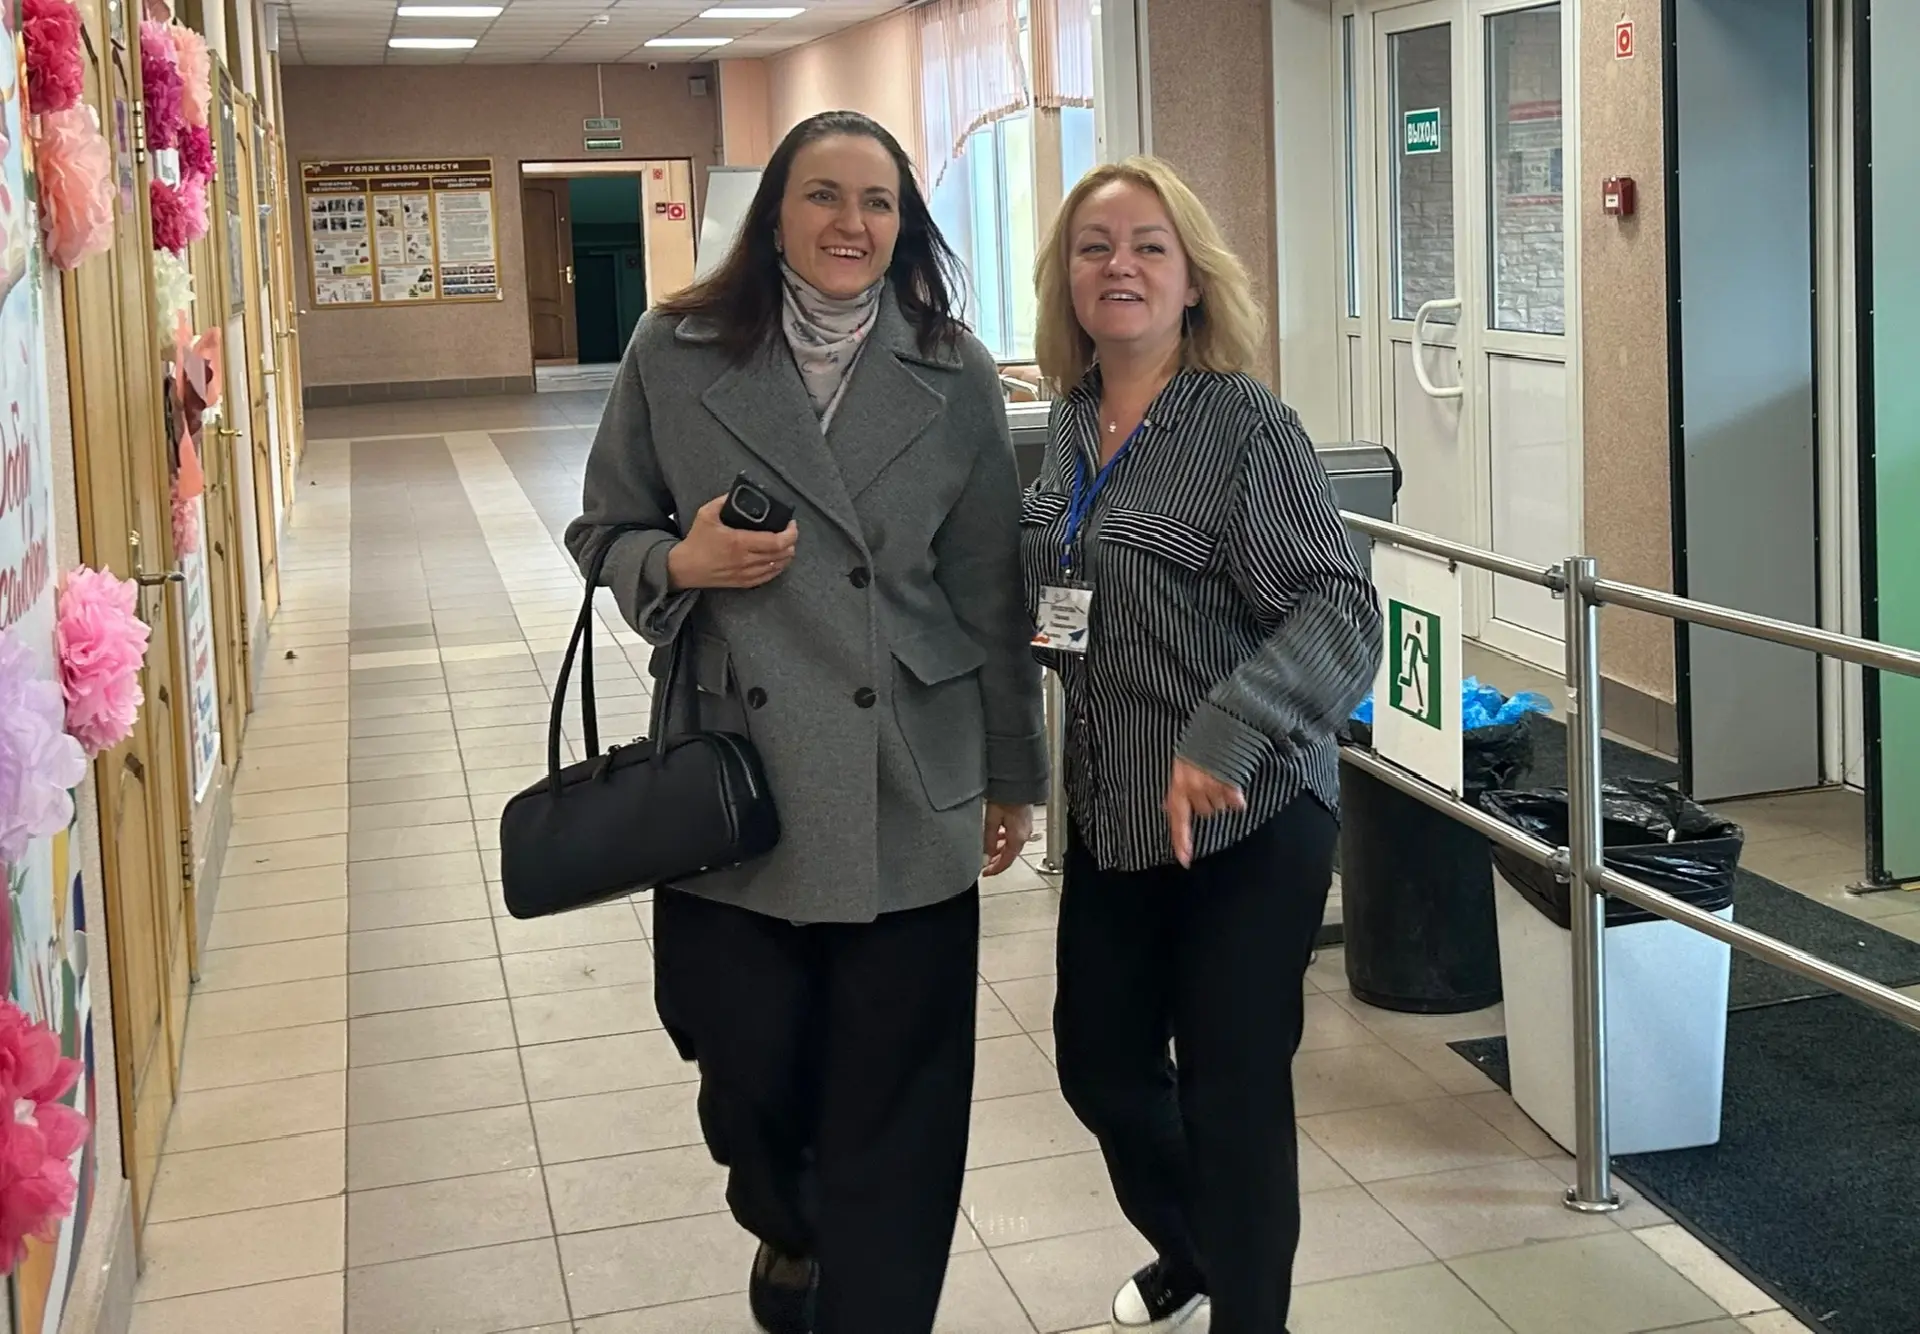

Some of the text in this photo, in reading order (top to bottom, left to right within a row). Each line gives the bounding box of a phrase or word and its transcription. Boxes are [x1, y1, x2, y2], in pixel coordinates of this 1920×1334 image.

[1407, 121, 1438, 146] ВЫХОД
[343, 162, 460, 174] УГОЛОК БЕЗОПАСНОСТИ
